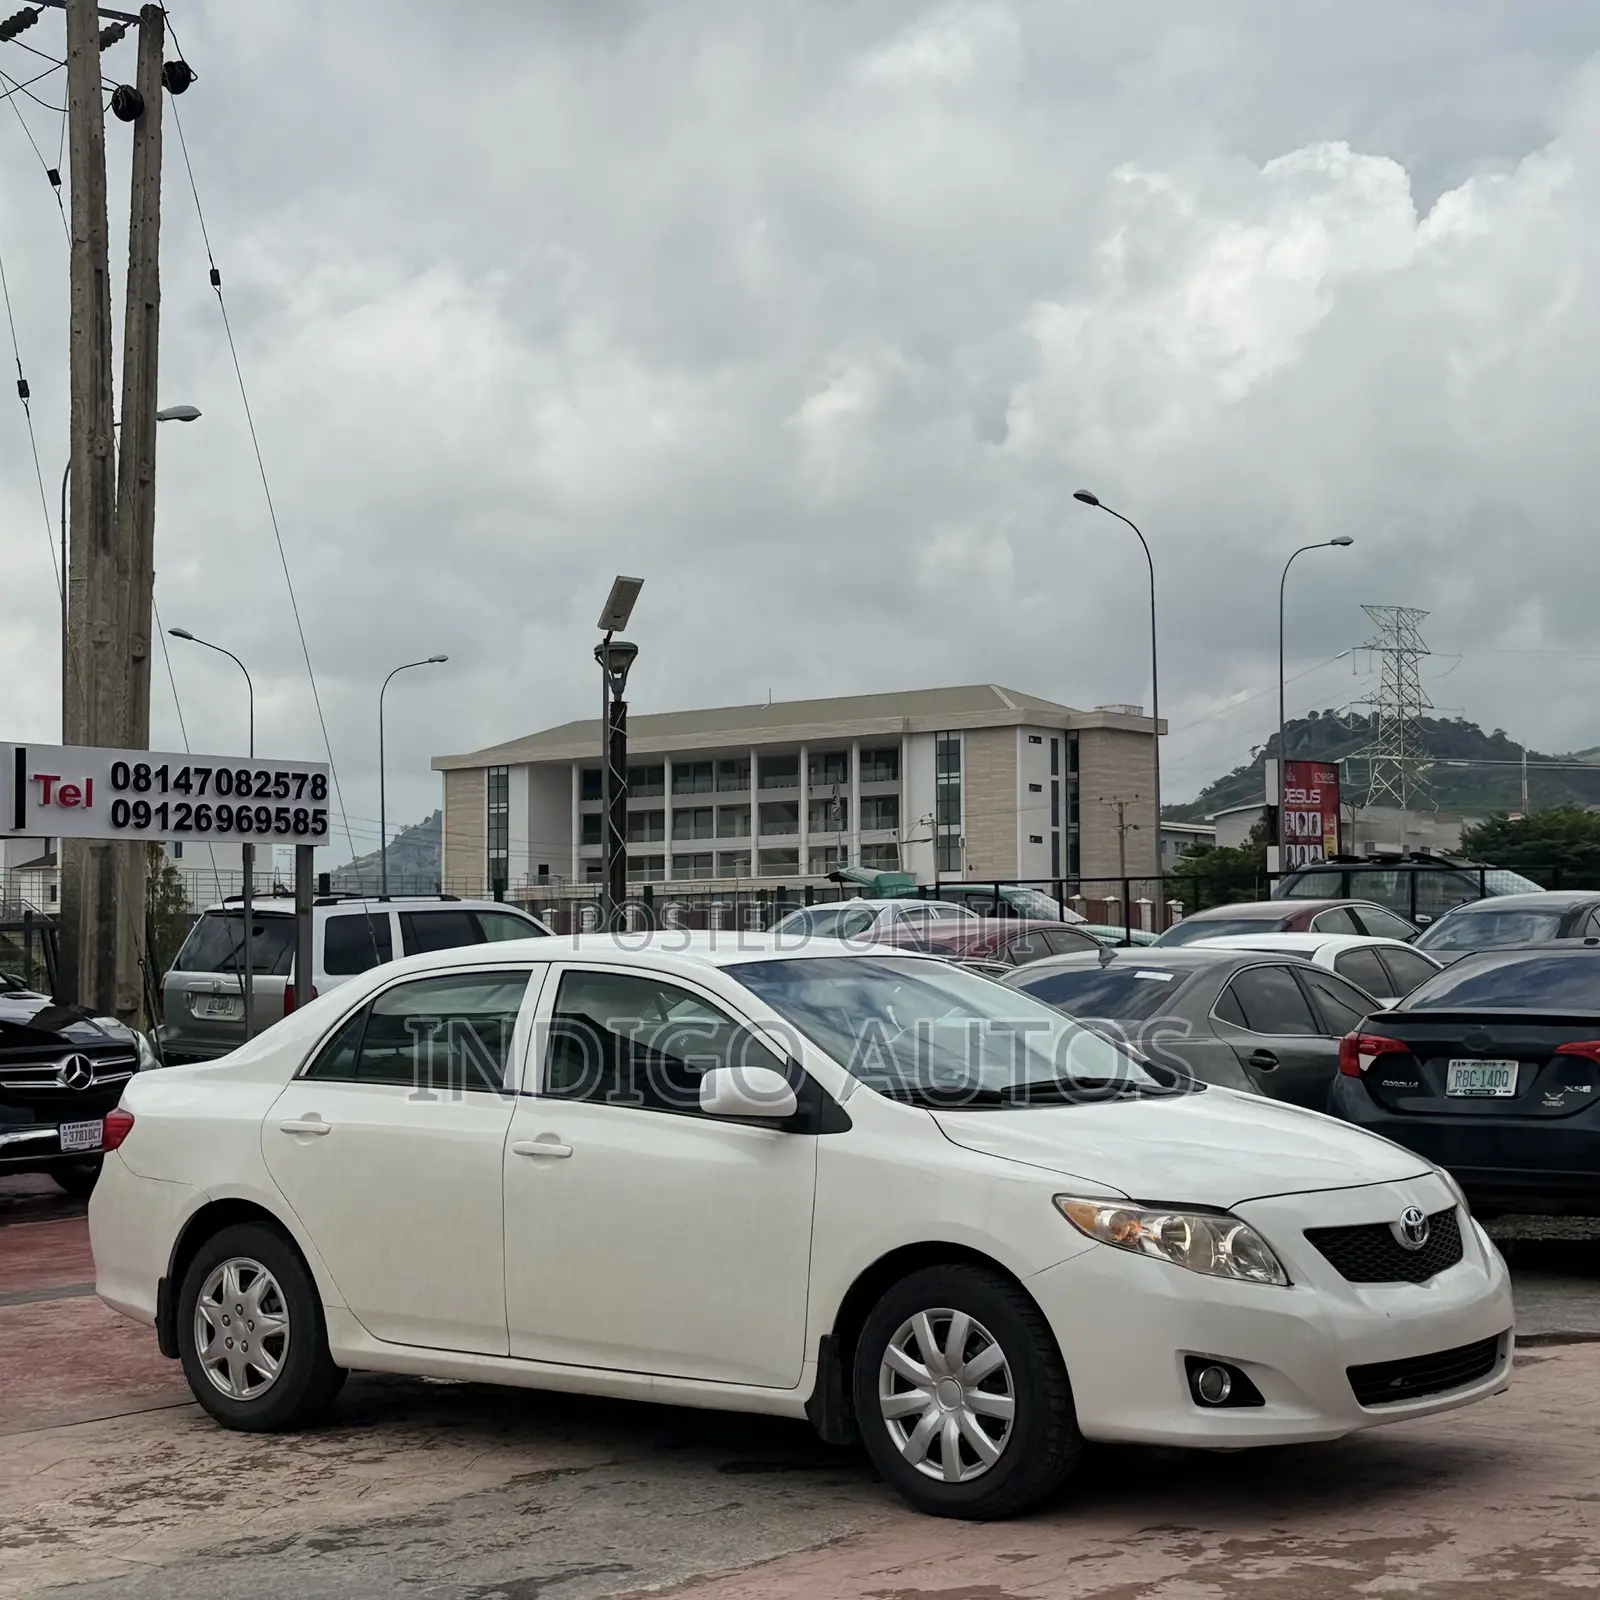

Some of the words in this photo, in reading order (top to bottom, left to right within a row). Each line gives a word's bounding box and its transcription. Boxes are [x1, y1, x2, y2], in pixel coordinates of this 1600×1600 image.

[32, 774, 93, 808] Tel
[110, 761, 327, 801] 08147082578
[110, 799, 328, 836] 09126969585
